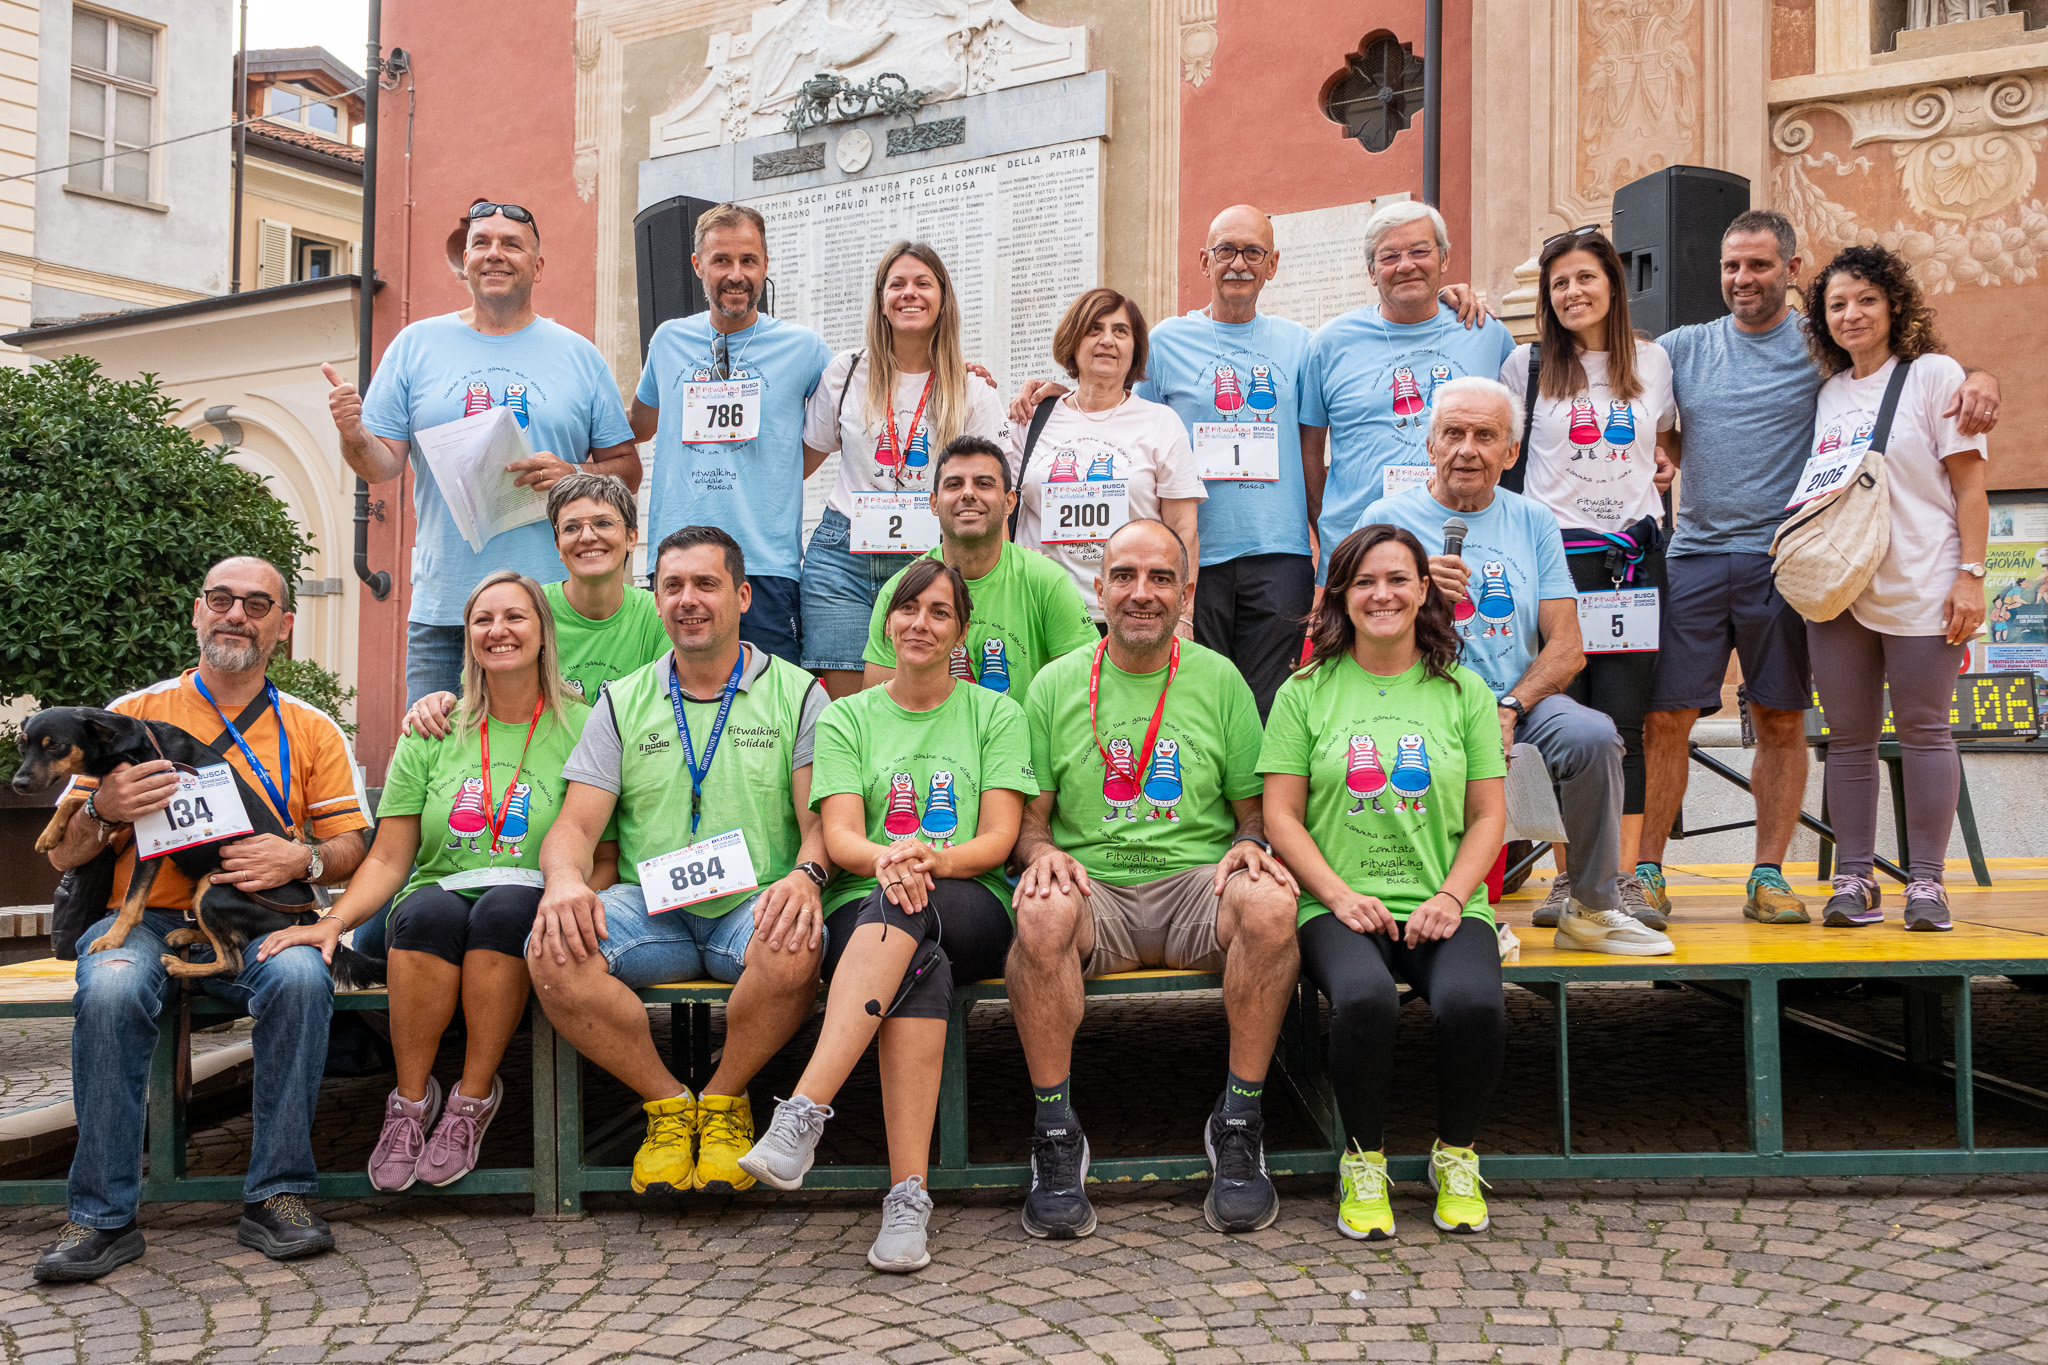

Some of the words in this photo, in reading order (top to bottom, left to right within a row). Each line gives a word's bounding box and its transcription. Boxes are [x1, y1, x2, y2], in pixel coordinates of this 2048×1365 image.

[755, 202, 792, 212] TERMINI
[798, 194, 826, 206] SACRI
[836, 189, 853, 199] CHE
[863, 181, 901, 195] NATURA
[910, 176, 935, 187] POSE
[942, 173, 948, 181] A
[955, 164, 997, 179] CONFINE
[1007, 156, 1041, 169] DELLA
[1050, 148, 1086, 161] PATRIA
[765, 209, 810, 224] ONTARONO
[824, 198, 868, 214] IMPAVIDI
[881, 190, 911, 203] MORTE
[925, 181, 976, 197] GLORIOSA
[702, 384, 740, 393] Fitwalking
[706, 404, 744, 428] 786
[1211, 426, 1250, 435] Fitwalking
[1233, 444, 1240, 465] 1
[691, 468, 736, 480] Fitwalking
[1805, 464, 1848, 493] 2106
[1060, 486, 1100, 494] Fitwalking
[870, 497, 912, 505] Fitwalking
[1577, 498, 1624, 508] Fitwalking
[1060, 503, 1110, 528] 2100
[889, 515, 902, 538] 2
[1985, 558, 2035, 570] GIOVANI
[1984, 577, 2016, 588] GIOIA
[1612, 614, 1624, 637] 5
[671, 686, 685, 728] ASSICURAZIONI
[701, 735, 718, 771] GIOVANNONE
[714, 691, 733, 735] ASSICURAZIONI
[728, 725, 780, 739] Fitwalking
[679, 729, 693, 765] GIOVANNONE
[733, 738, 774, 748] Solidale
[199, 776, 228, 785] DOMENICA
[164, 796, 213, 832] 134
[711, 833, 739, 844] BUSCA
[1368, 845, 1415, 853] Comitato
[1106, 851, 1166, 867] Fitwalking
[1360, 857, 1423, 872] Fitwalking
[669, 856, 725, 891] 884
[1367, 868, 1406, 877] solidale
[1386, 877, 1419, 885] Busca
